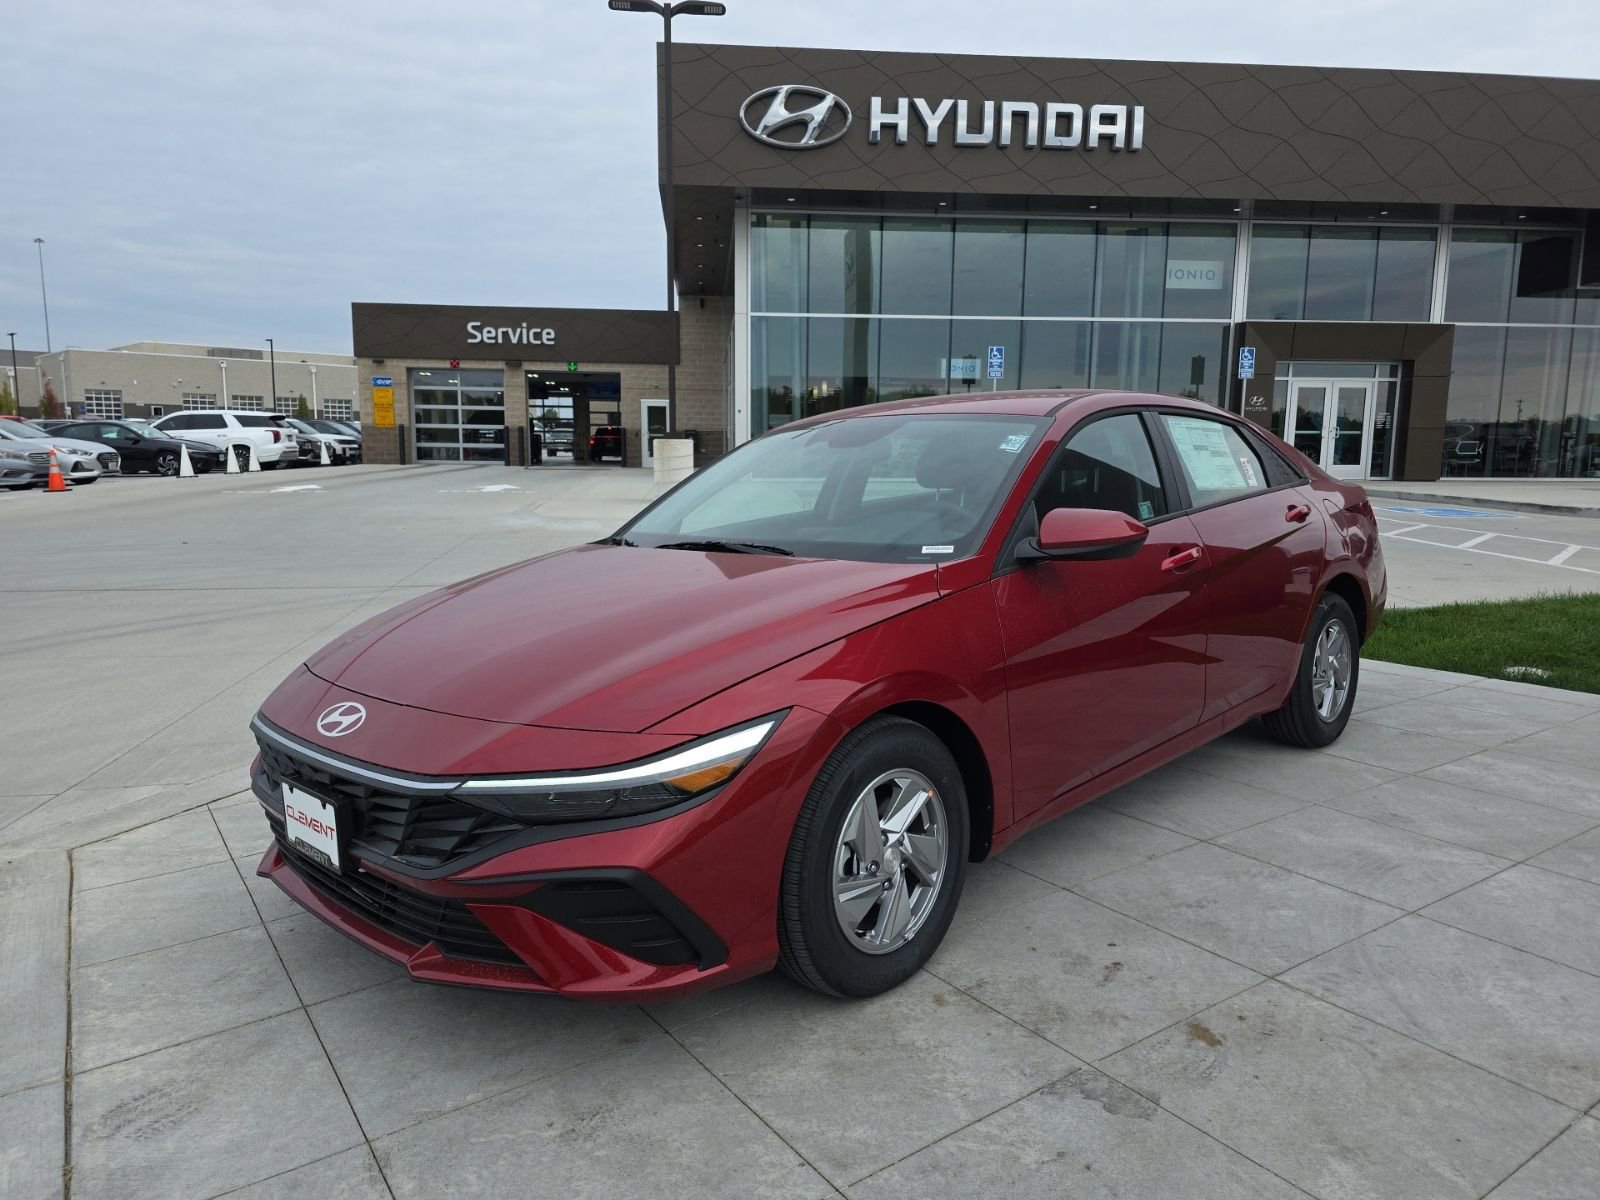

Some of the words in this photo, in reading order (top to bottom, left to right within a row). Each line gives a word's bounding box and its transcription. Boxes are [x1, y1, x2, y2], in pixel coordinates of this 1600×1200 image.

[868, 96, 1145, 152] HYUNDAI
[1168, 268, 1216, 281] IONIQ
[467, 321, 556, 346] Service
[287, 805, 335, 840] CLEMENT
